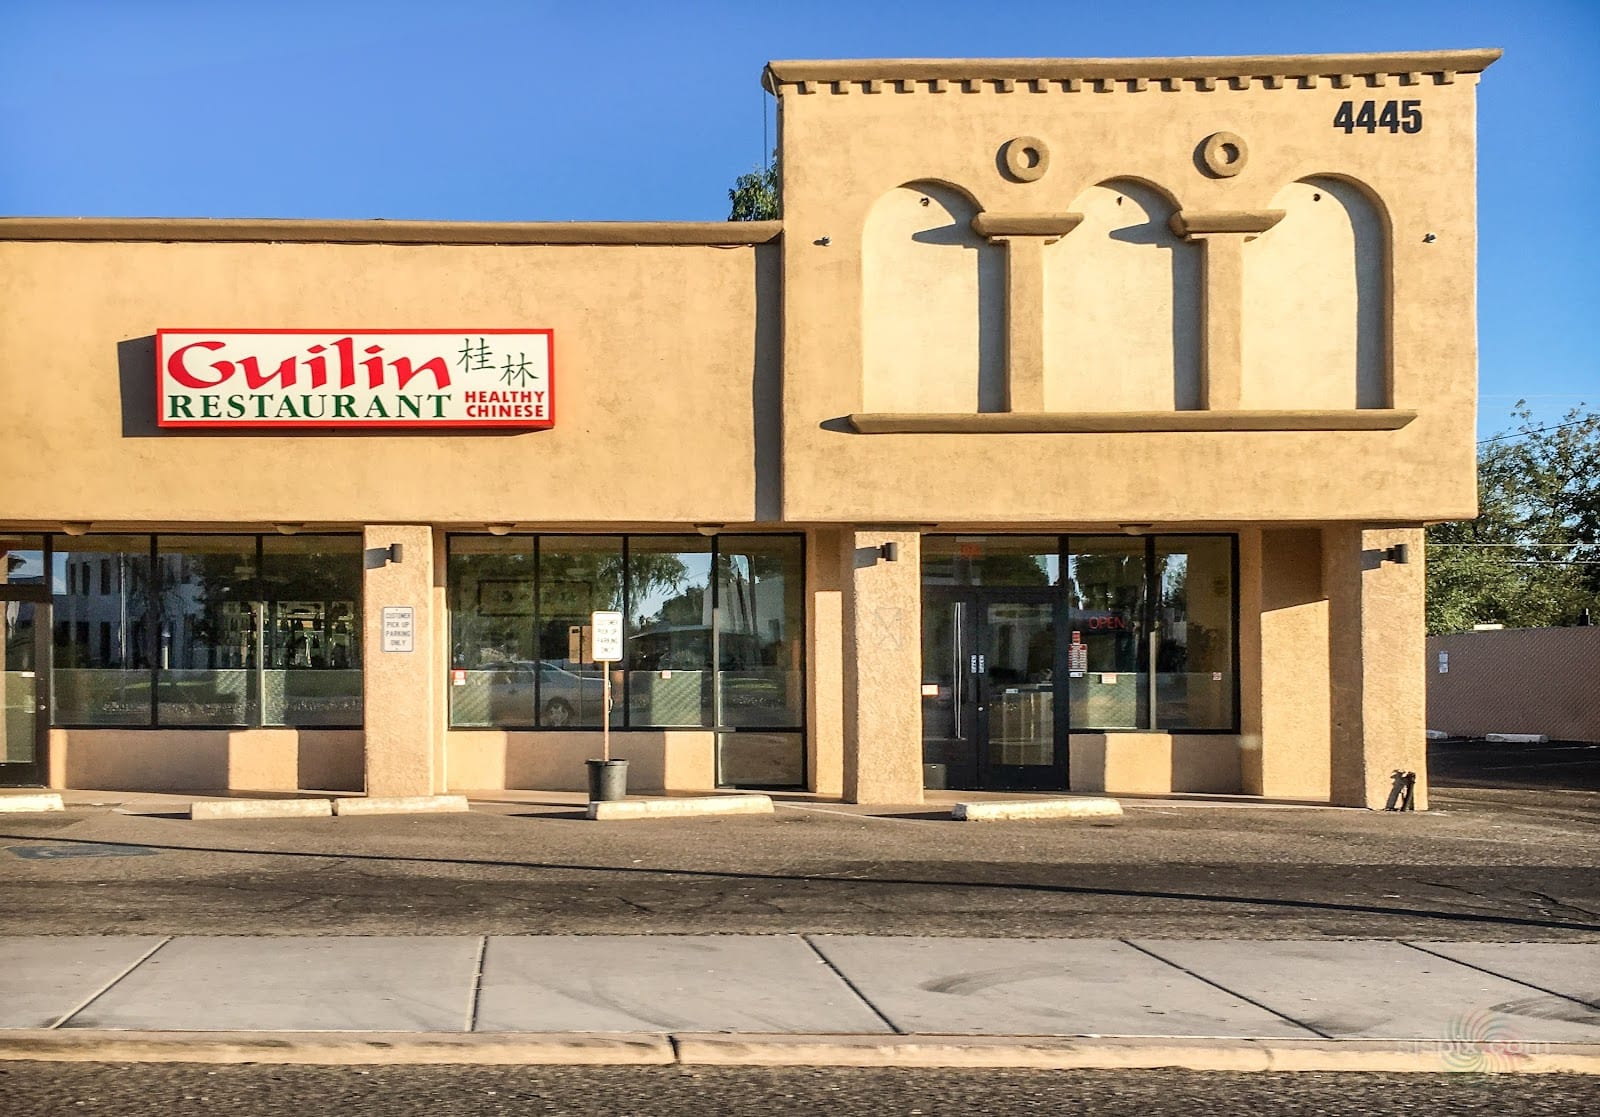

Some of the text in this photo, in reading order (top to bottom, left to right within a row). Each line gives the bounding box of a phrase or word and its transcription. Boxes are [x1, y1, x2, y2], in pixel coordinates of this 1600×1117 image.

[1333, 99, 1423, 134] 4445
[167, 337, 452, 390] Guilin
[456, 337, 540, 388] 桂林
[168, 394, 452, 419] RESTAURANT
[465, 391, 545, 403] HEALTHY
[466, 405, 544, 417] CHINESE
[1088, 616, 1125, 630] OPEN
[390, 639, 407, 647] ONLY
